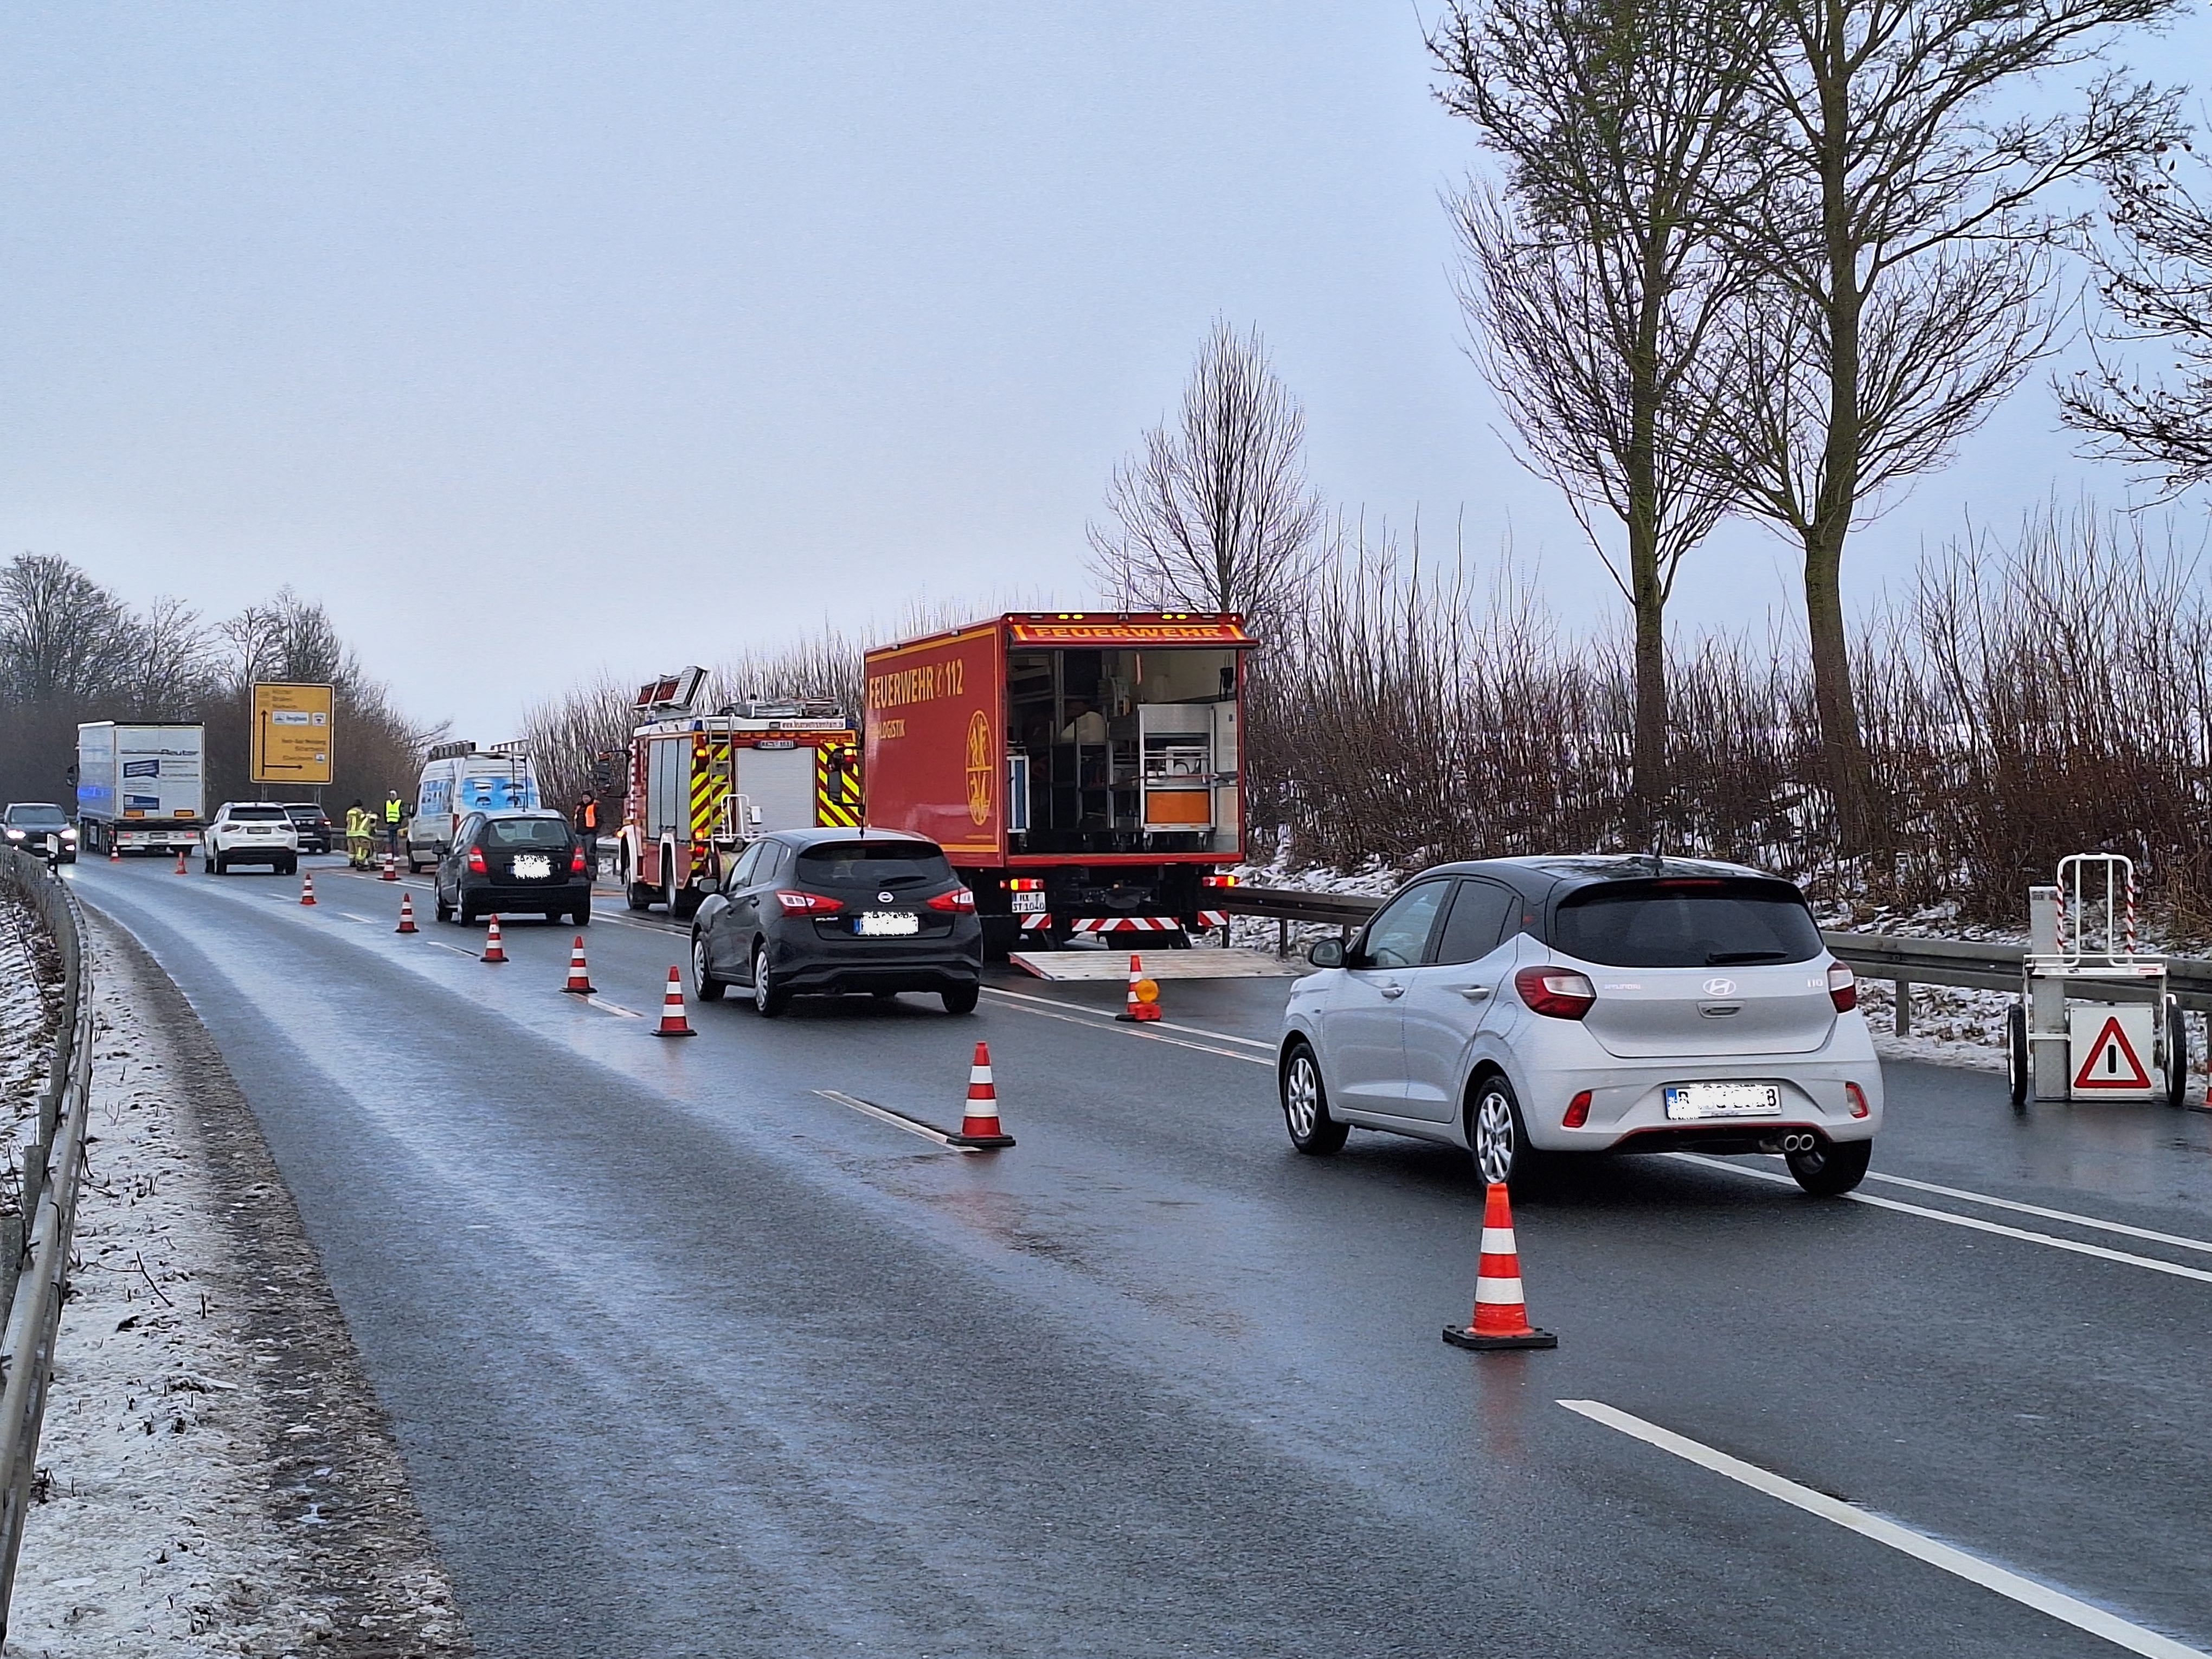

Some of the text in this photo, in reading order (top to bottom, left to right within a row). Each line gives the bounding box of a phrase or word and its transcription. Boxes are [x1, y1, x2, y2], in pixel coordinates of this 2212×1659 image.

[1034, 628, 1223, 638] FEUERWEHR
[869, 658, 963, 709] FEUERWEHR 112
